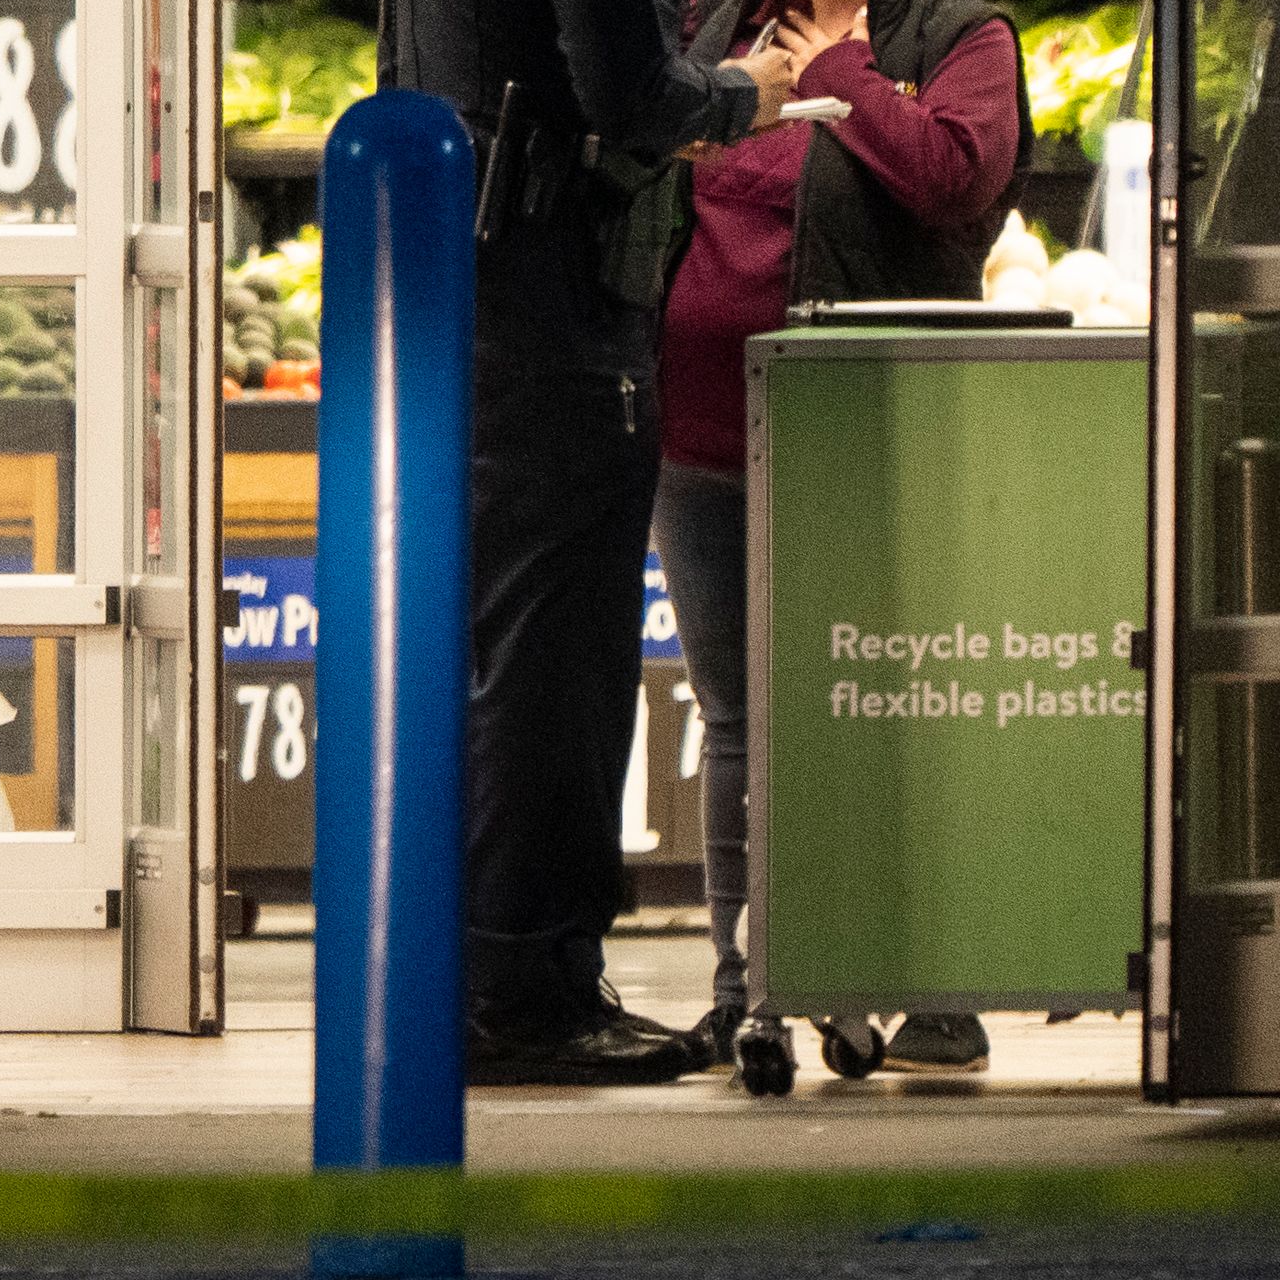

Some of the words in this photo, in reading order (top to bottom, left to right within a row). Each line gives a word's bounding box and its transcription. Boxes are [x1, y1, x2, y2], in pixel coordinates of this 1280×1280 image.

[831, 622, 990, 670] Recycle
[1002, 622, 1099, 669] bags
[1111, 619, 1136, 659] &
[830, 679, 985, 718] flexible
[996, 678, 1147, 727] plastics
